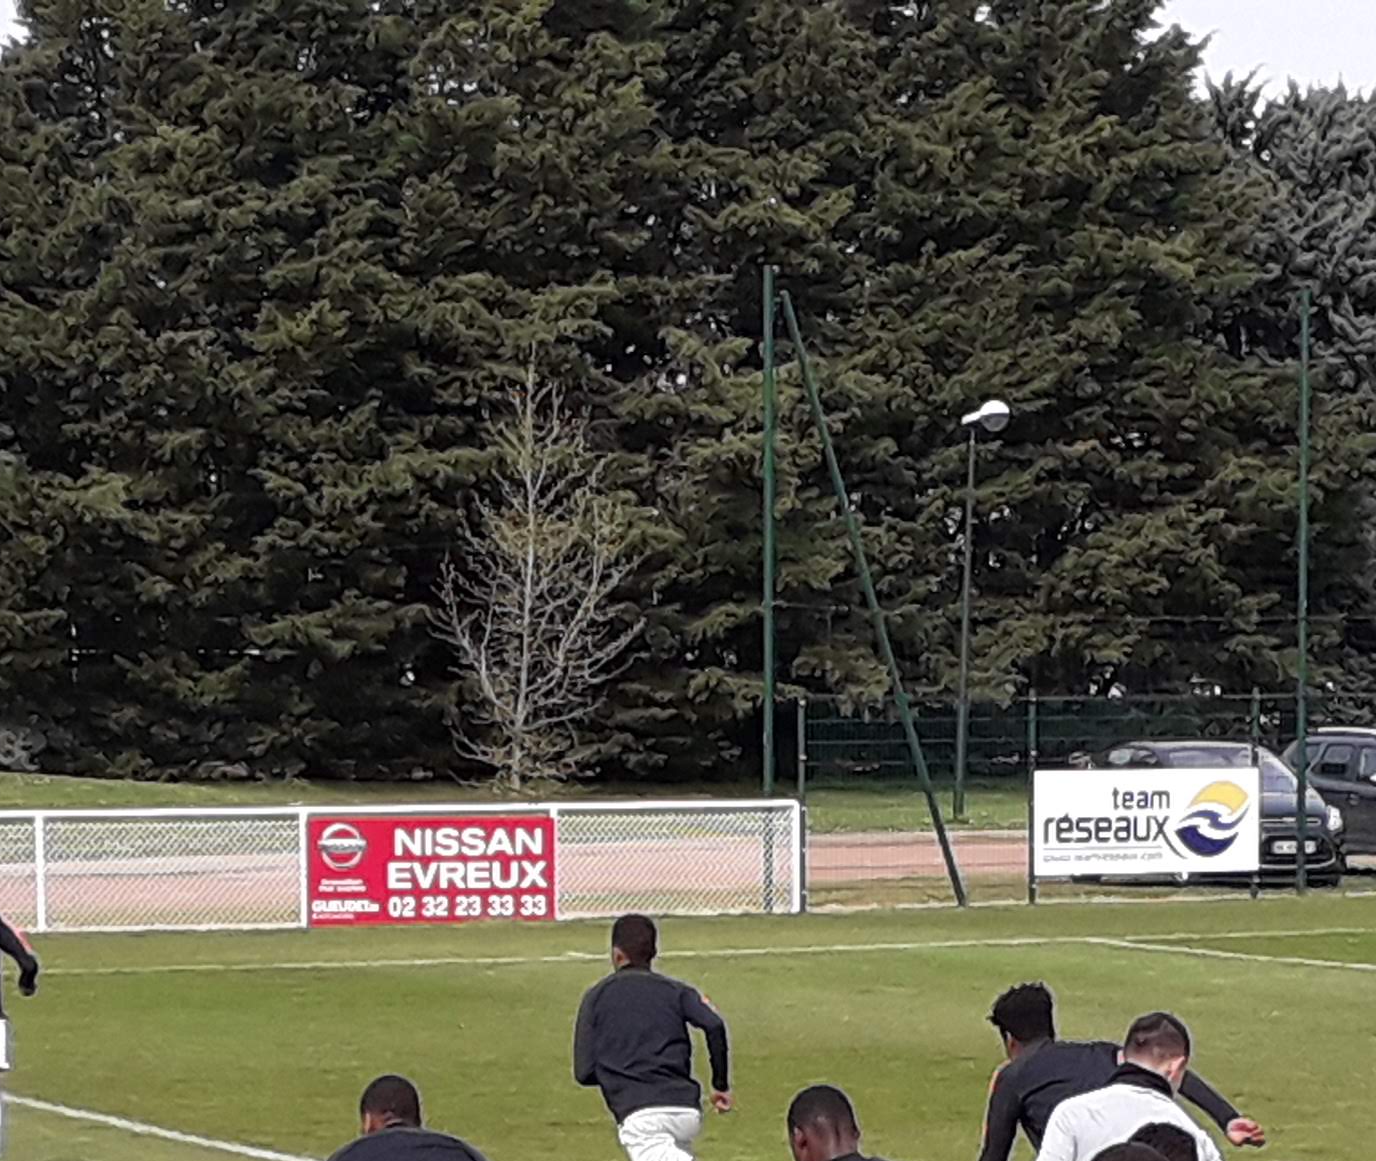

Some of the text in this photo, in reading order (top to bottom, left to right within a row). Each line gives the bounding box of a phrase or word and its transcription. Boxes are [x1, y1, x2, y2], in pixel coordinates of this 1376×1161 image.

[1111, 787, 1170, 810] team
[393, 827, 543, 856] NISSAN
[1043, 813, 1188, 859] réseaux
[387, 861, 548, 890] EVREUX
[387, 897, 416, 918] 02
[421, 897, 448, 917] 32
[454, 897, 482, 917] 23
[487, 896, 514, 917] 33
[520, 895, 547, 917] 33
